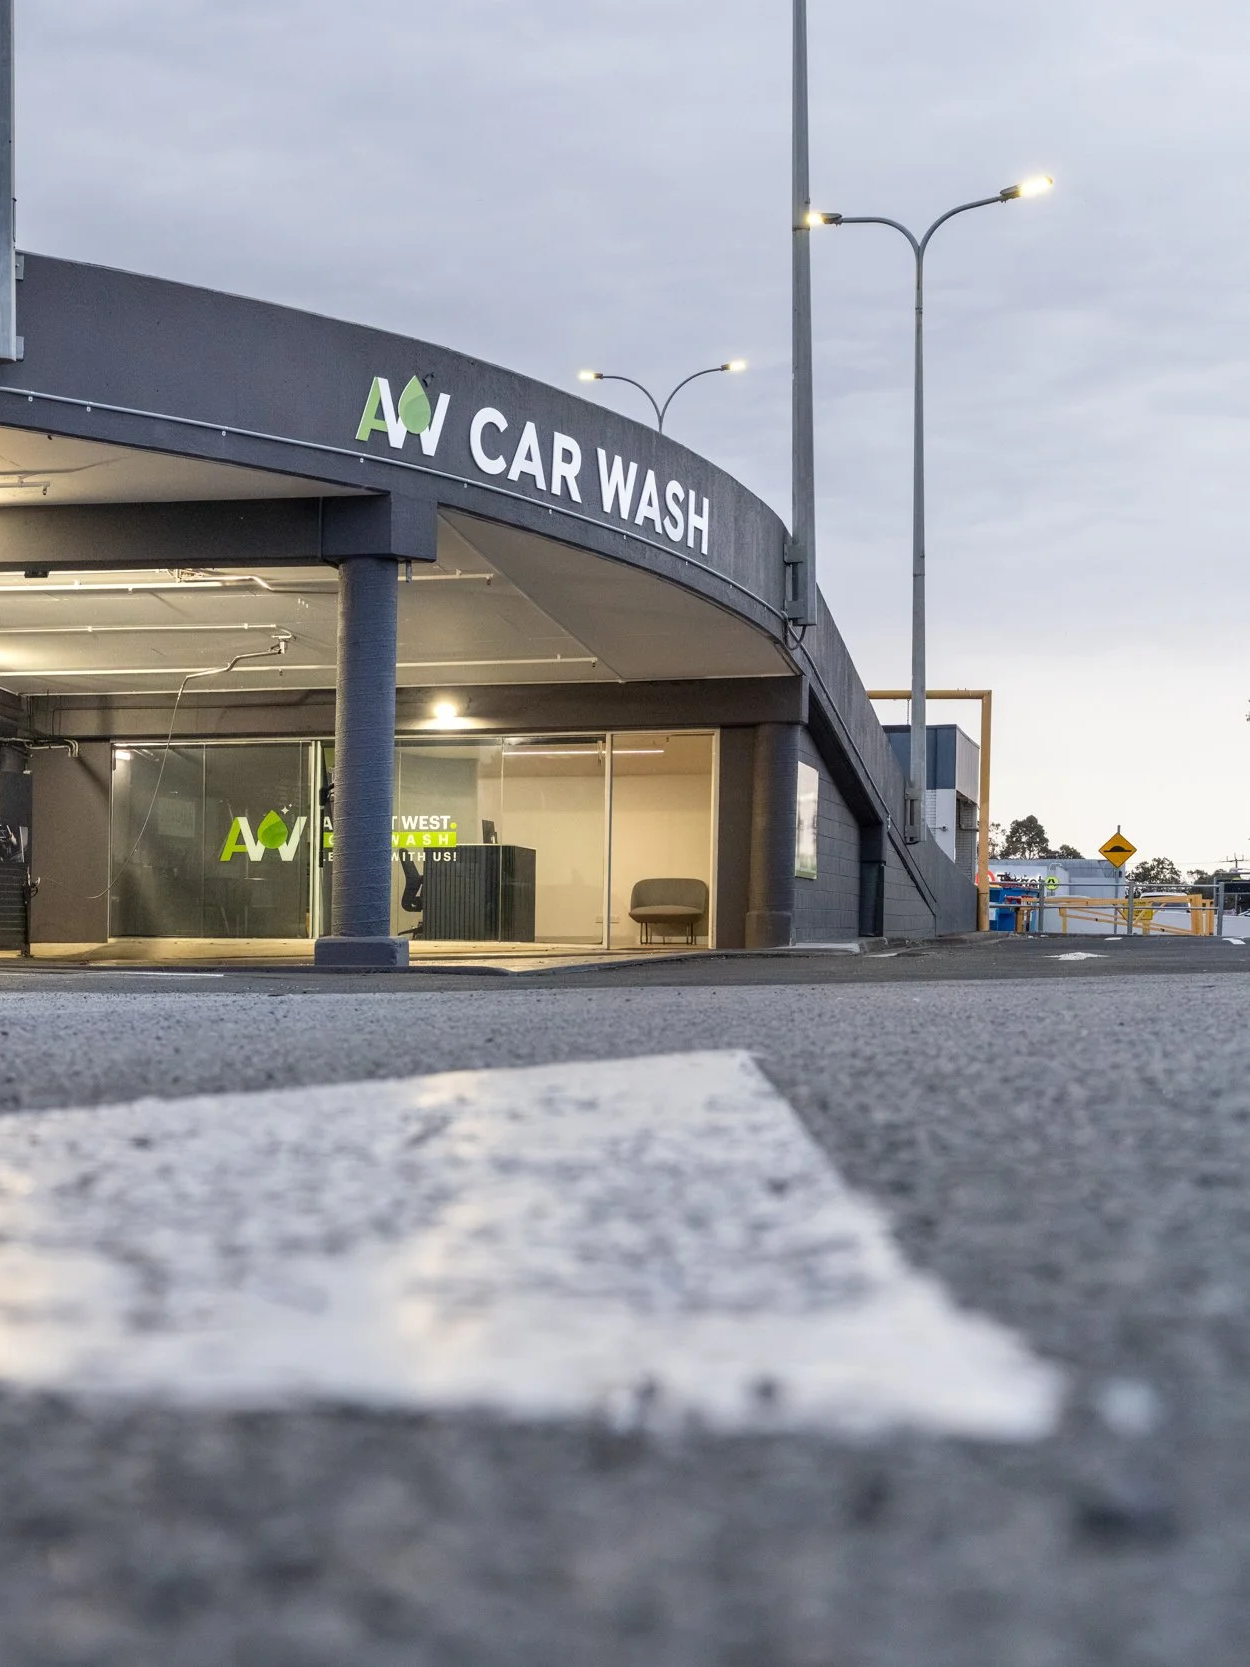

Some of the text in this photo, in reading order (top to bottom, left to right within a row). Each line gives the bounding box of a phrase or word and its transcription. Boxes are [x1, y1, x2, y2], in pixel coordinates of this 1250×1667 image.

[469, 406, 583, 504] CAR
[596, 447, 710, 556] WASH
[432, 851, 457, 862] US!
